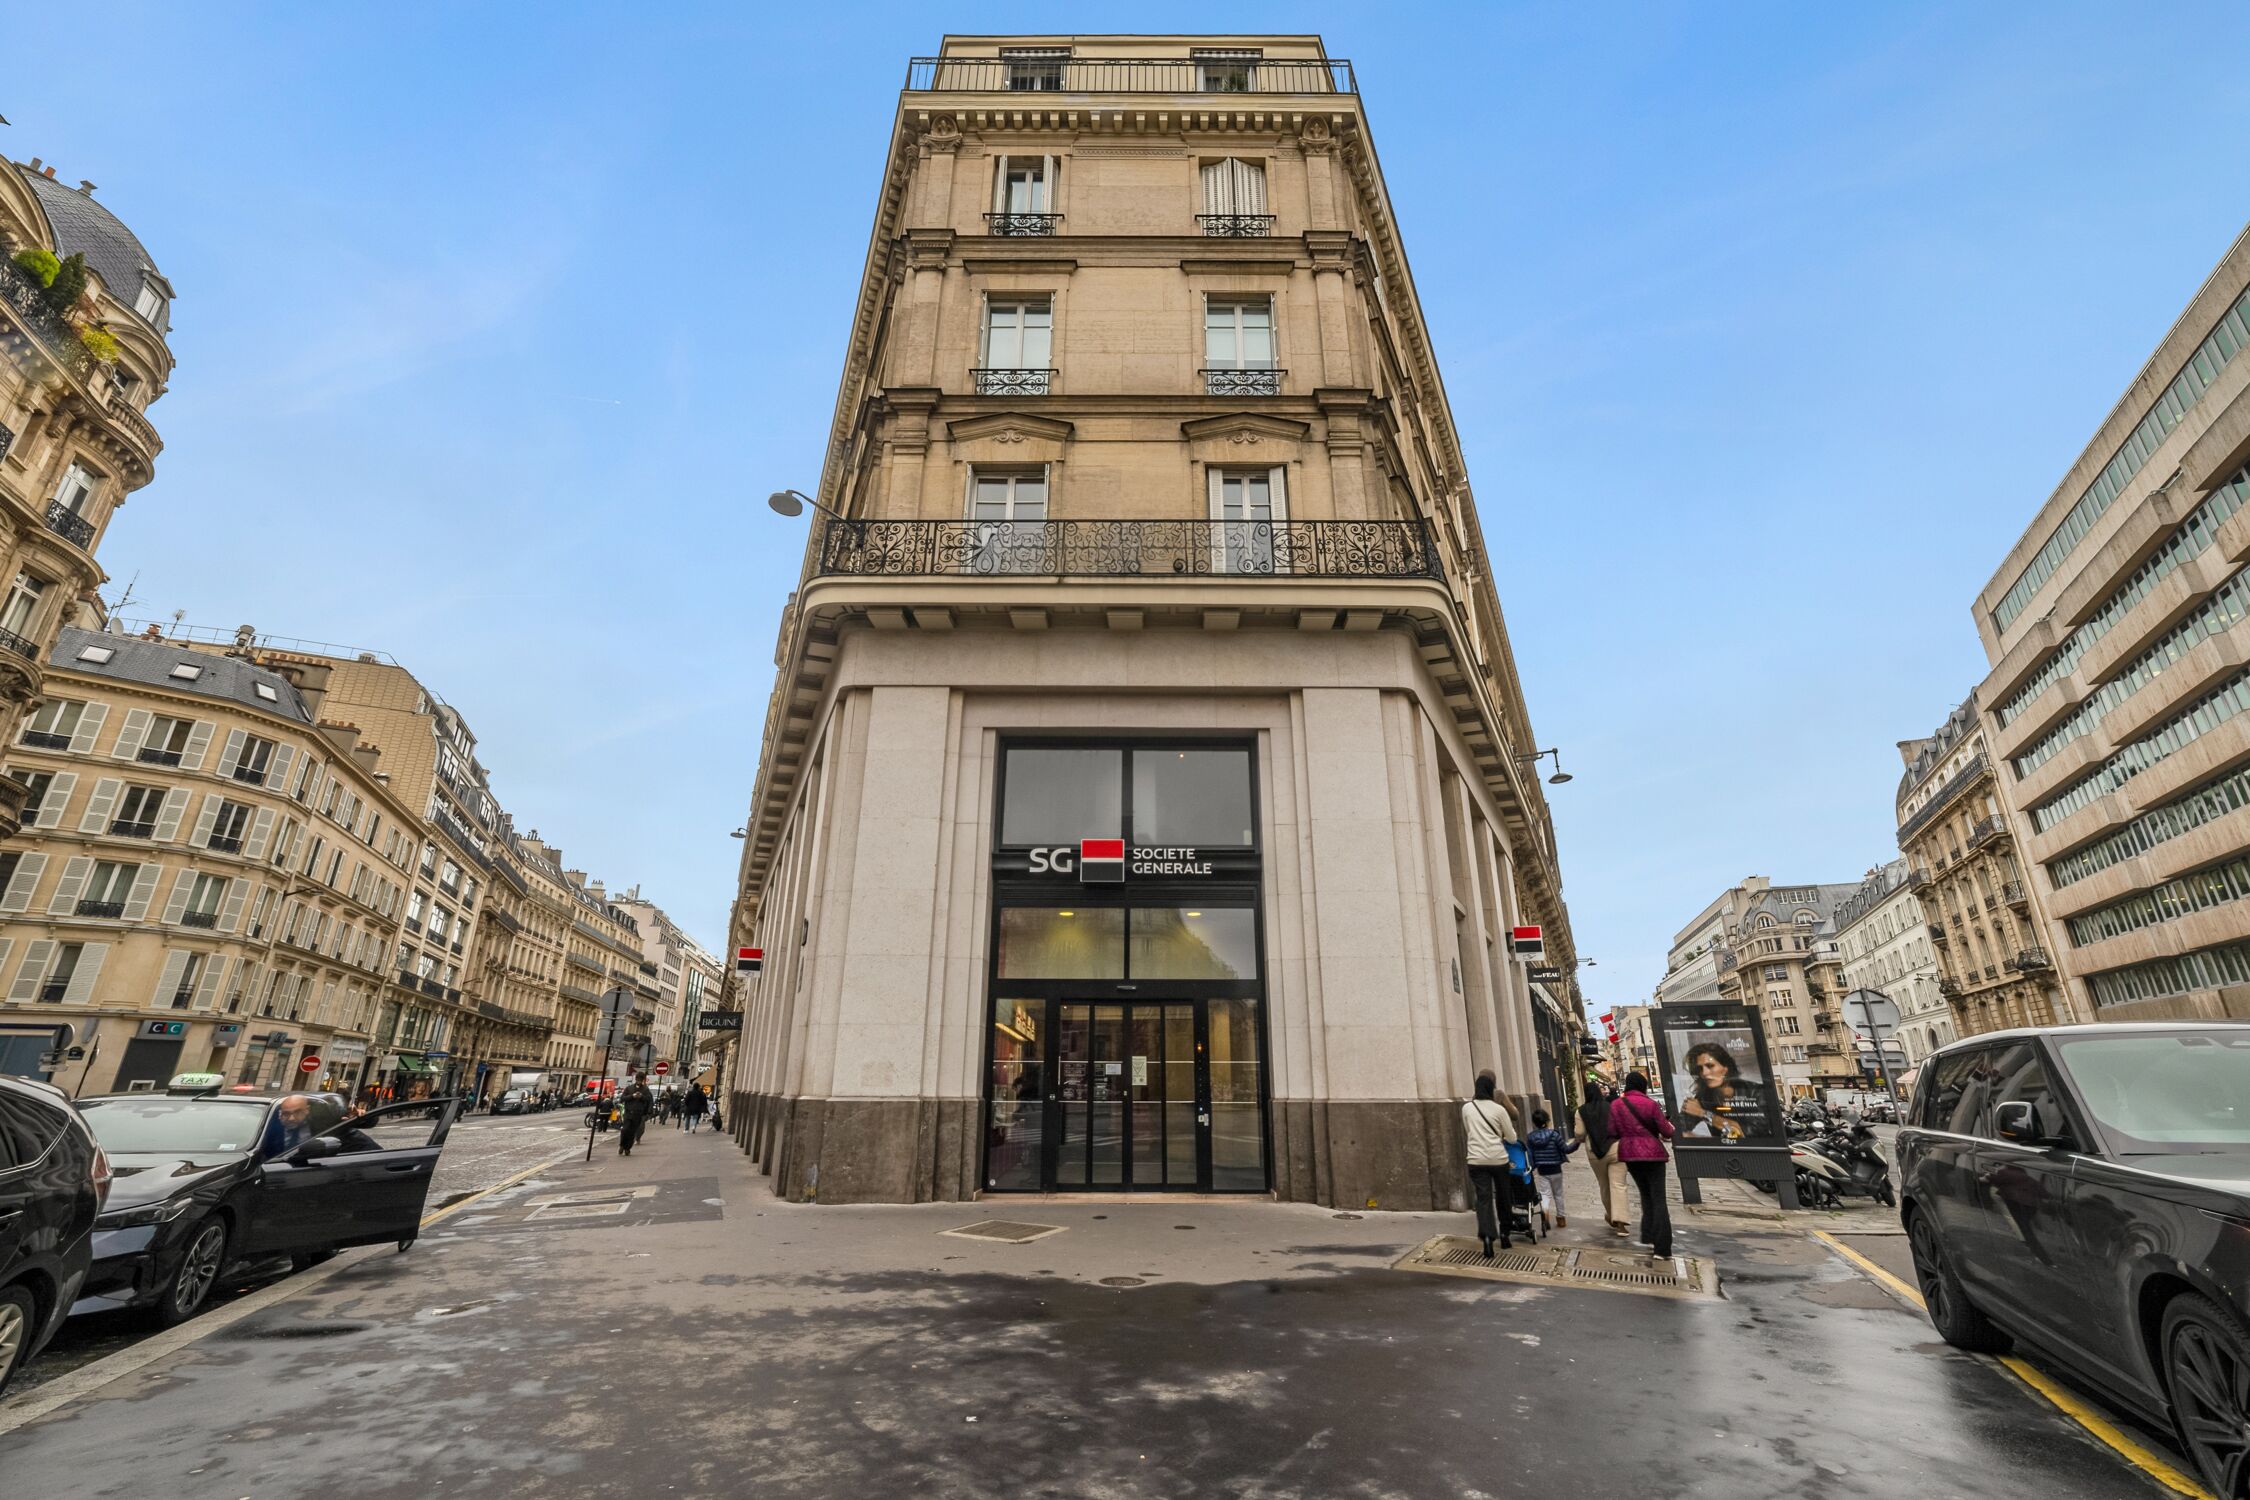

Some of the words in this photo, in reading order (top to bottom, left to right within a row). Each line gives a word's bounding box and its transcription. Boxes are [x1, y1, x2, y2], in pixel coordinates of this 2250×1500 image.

[1029, 847, 1073, 873] SG
[1133, 848, 1196, 860] SOCIETE
[1132, 862, 1212, 874] GENERALE
[152, 1023, 181, 1033] CIC
[702, 1018, 738, 1026] BIGUINE
